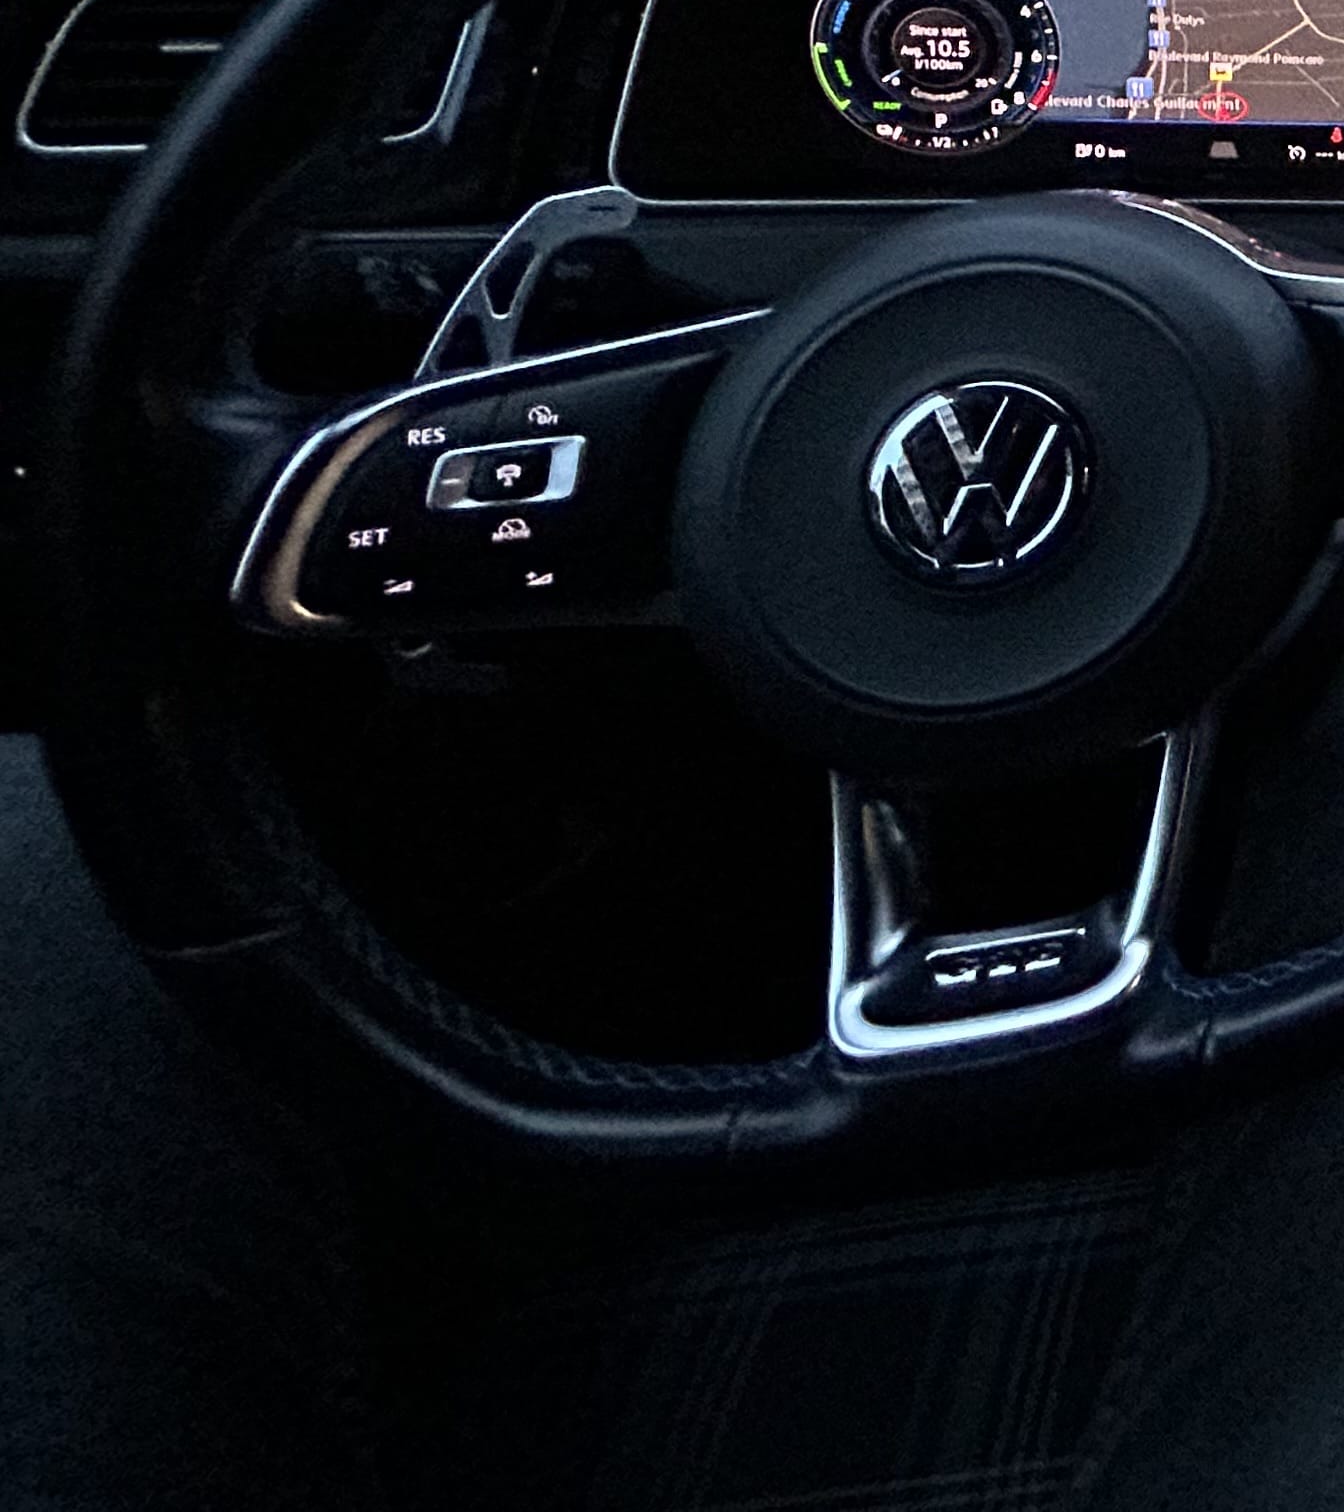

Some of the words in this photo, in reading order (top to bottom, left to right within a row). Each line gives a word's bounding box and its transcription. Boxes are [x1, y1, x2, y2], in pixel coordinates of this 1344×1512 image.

[926, 39, 971, 58] 10.5
[1031, 49, 1042, 63] 6
[935, 113, 948, 129] P
[1094, 143, 1105, 158] 0
[407, 427, 446, 446] RES
[348, 528, 389, 548] SET
